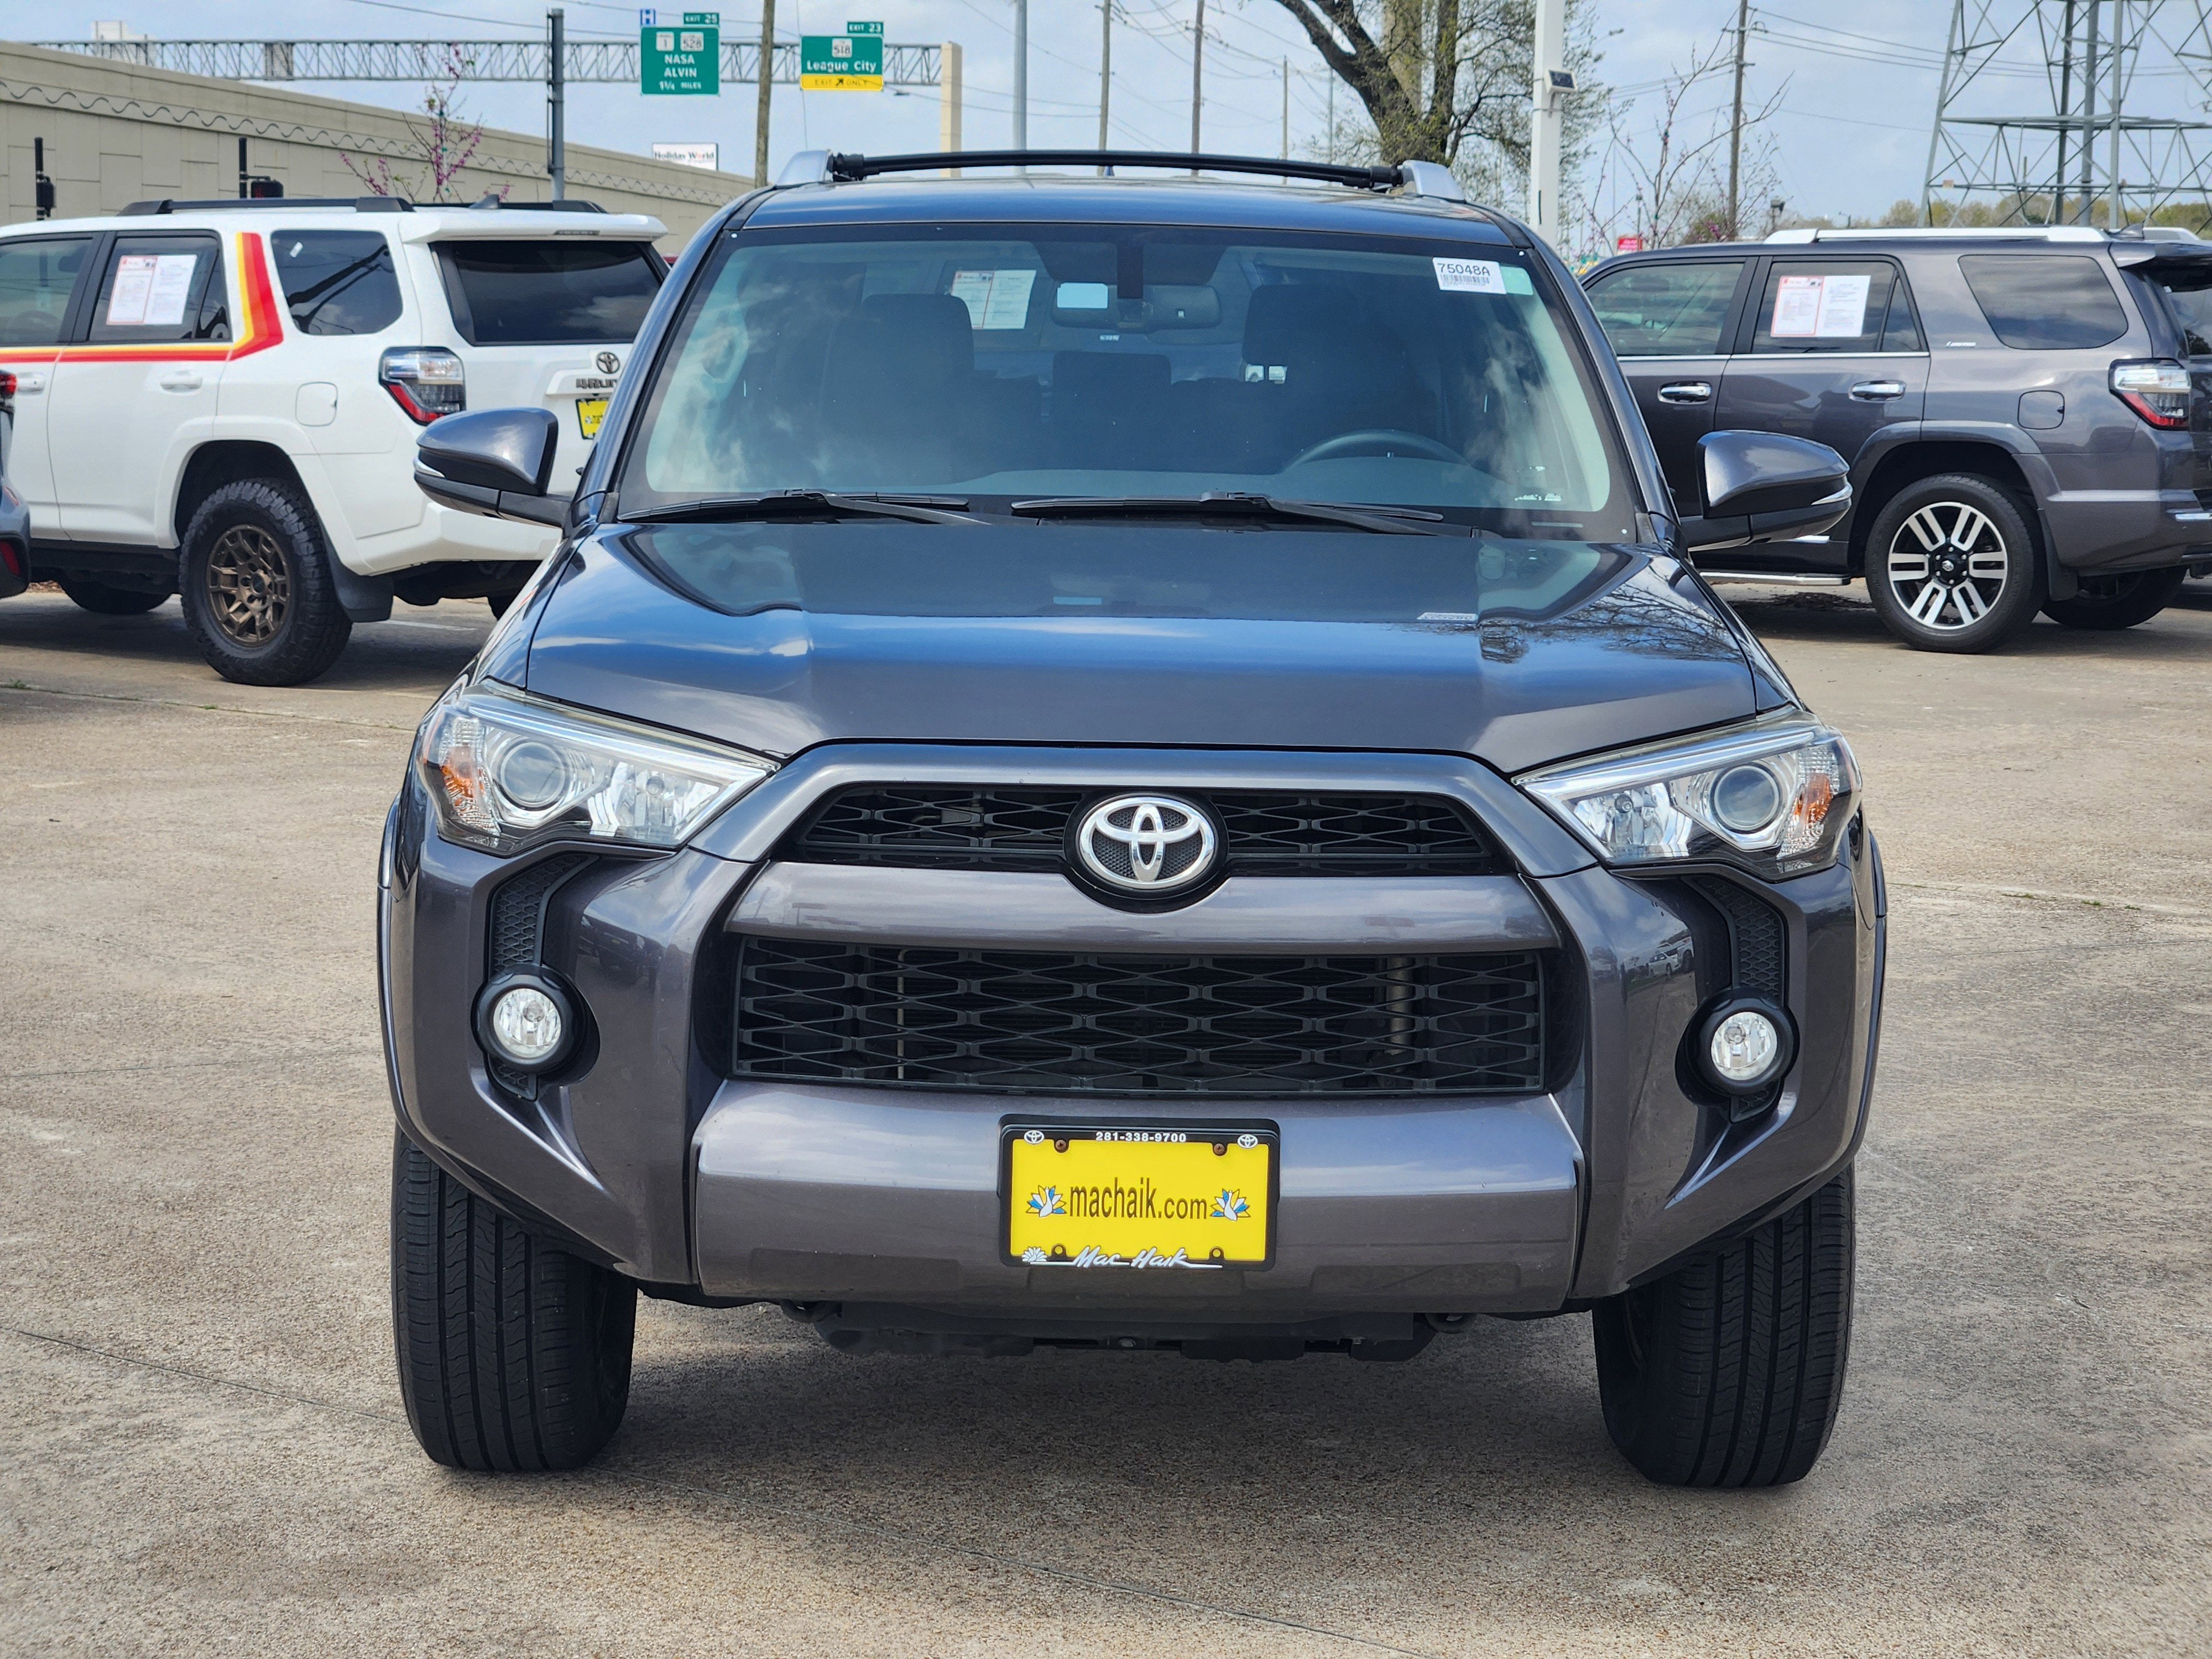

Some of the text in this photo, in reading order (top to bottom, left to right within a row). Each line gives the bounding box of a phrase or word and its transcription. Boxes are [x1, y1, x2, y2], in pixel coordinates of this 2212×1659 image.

[869, 23, 881, 33] 23
[833, 45, 851, 54] 518
[664, 54, 695, 65] NASA
[806, 60, 877, 73] League City
[664, 67, 697, 78] ALVIN
[1437, 263, 1490, 276] 75048A
[1095, 1131, 1187, 1142] 281-338-9700
[1070, 1177, 1207, 1220] machaik.com
[1071, 1245, 1130, 1268] Mac
